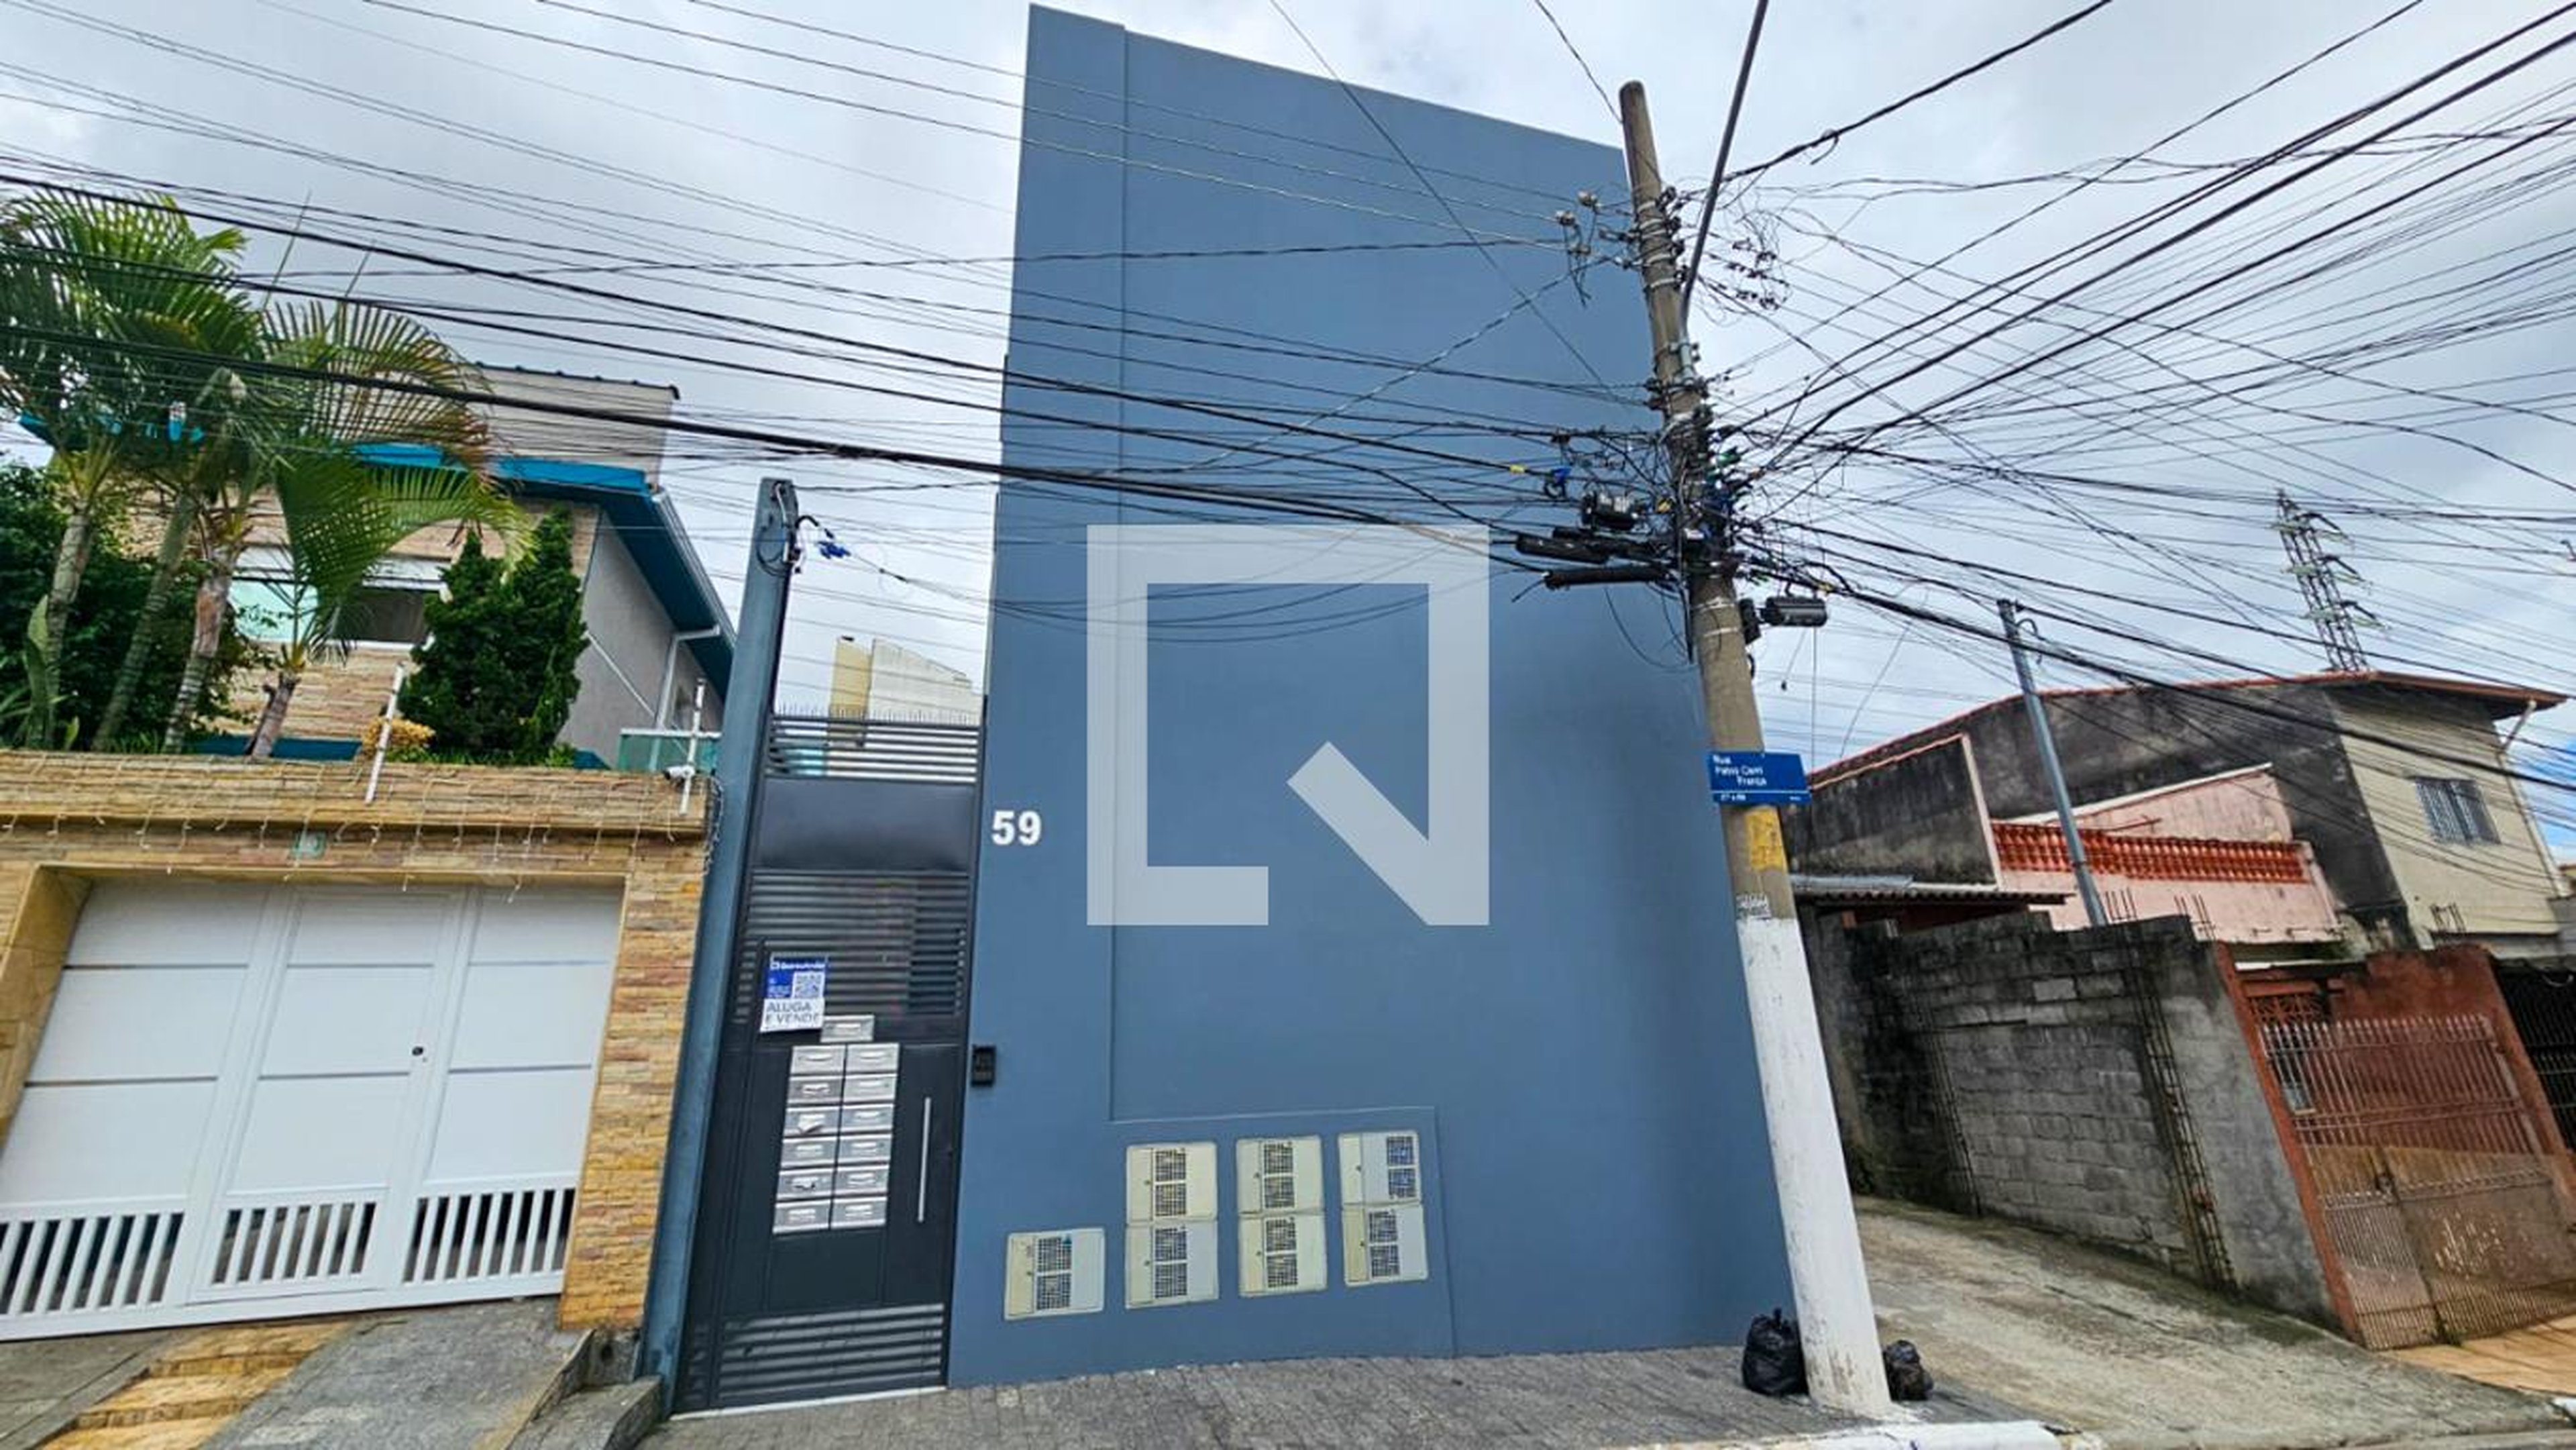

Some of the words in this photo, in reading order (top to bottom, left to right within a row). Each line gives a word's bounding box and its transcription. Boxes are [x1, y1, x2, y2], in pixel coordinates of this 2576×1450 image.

[1713, 754, 1732, 765] Rua
[991, 810, 1042, 846] 59
[766, 1002, 812, 1013] ALUGA
[777, 1013, 820, 1023] VENDE
